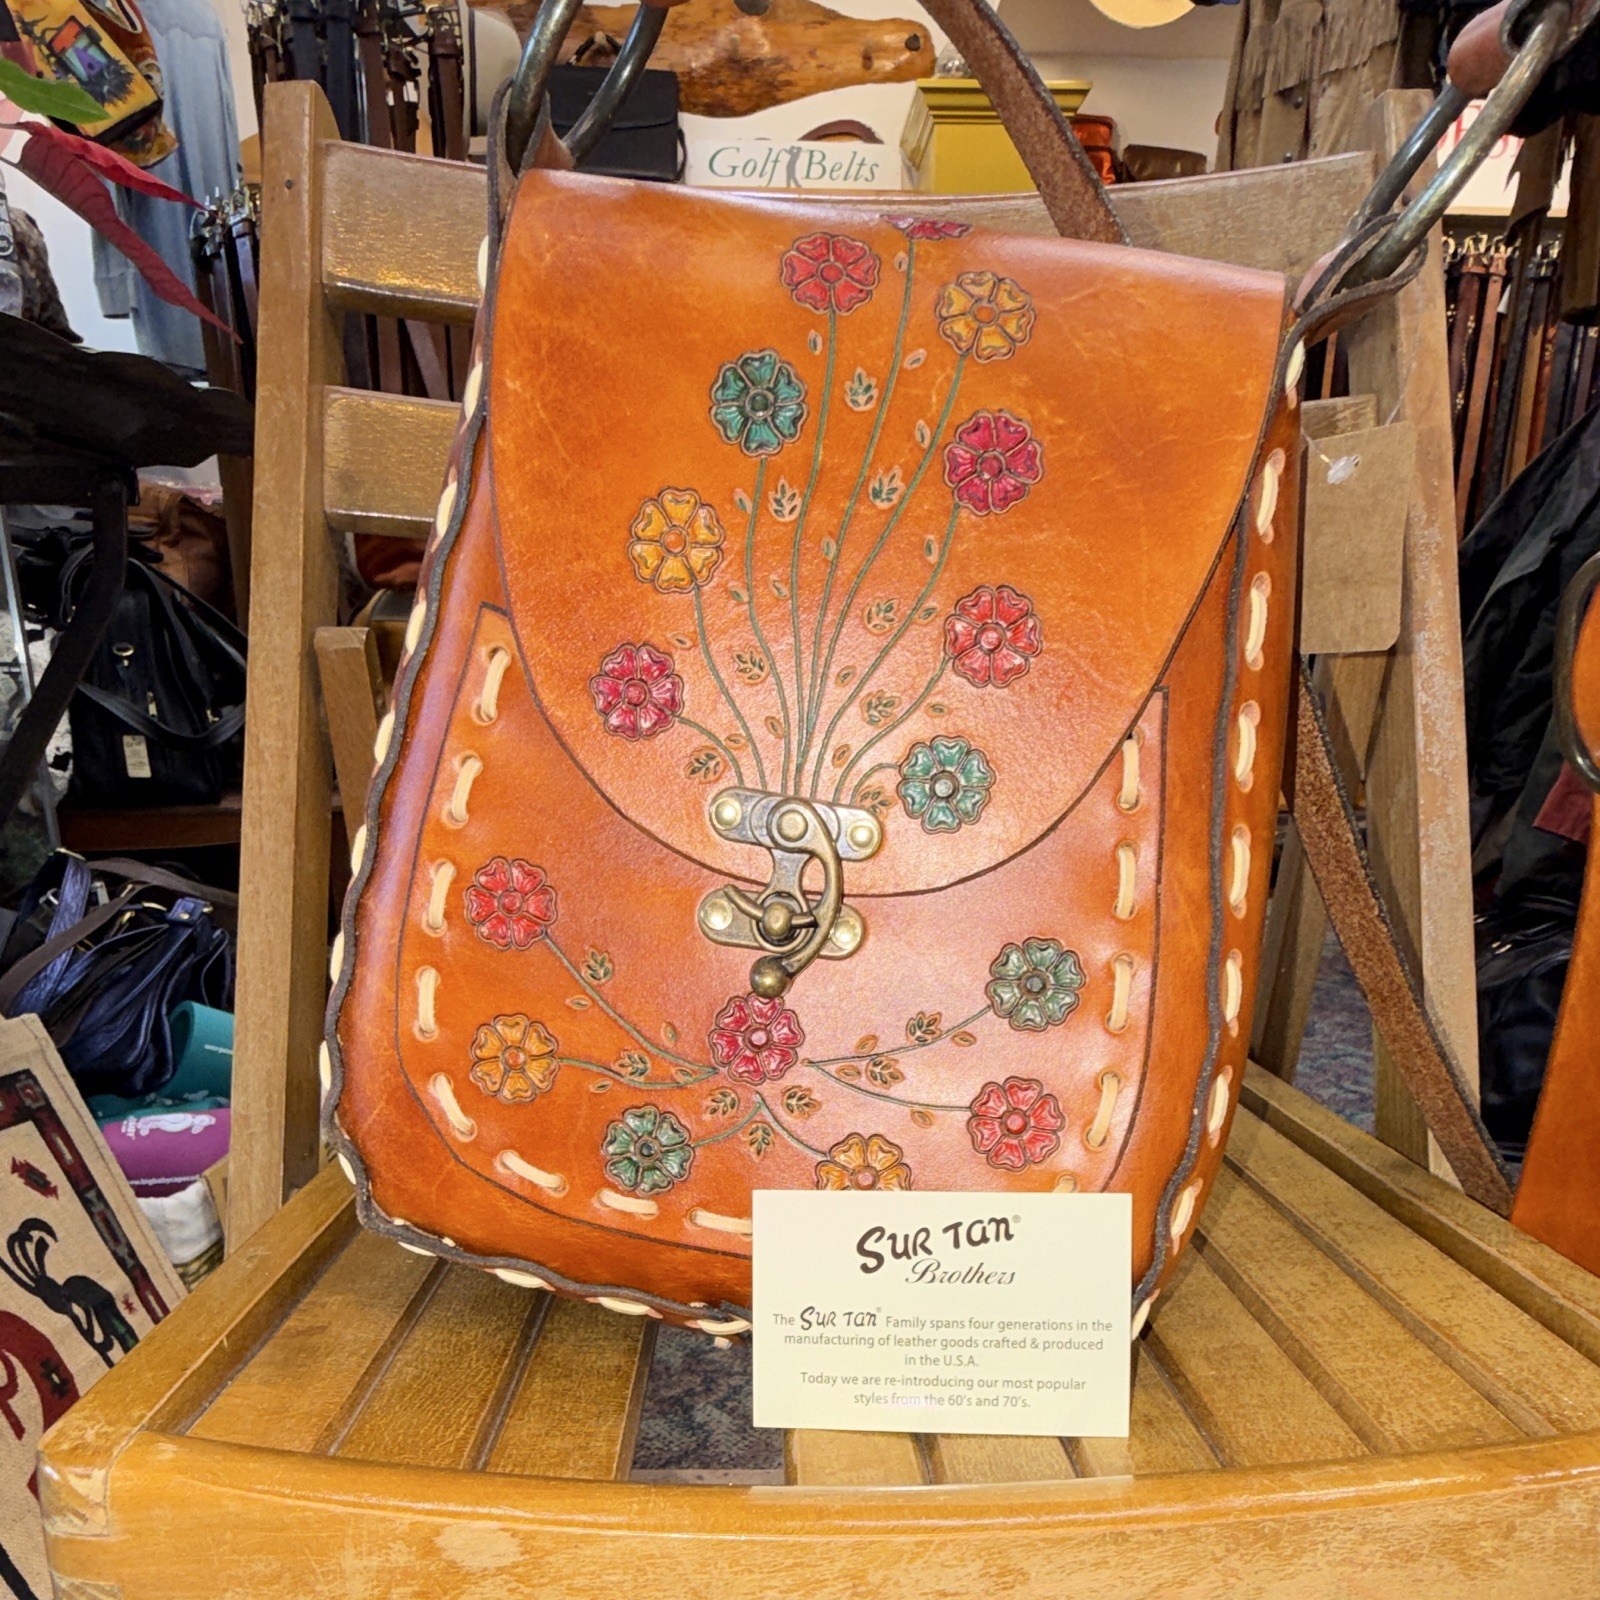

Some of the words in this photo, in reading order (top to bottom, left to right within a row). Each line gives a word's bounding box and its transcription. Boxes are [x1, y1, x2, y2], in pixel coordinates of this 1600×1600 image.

[708, 146, 787, 187] Golf
[801, 148, 879, 182] Belts
[905, 1258, 1016, 1285] Brothers
[773, 1313, 796, 1326] The
[886, 1316, 926, 1330] Family
[929, 1318, 966, 1331] spans
[968, 1317, 995, 1330] four
[997, 1319, 1073, 1333] generations
[1076, 1319, 1088, 1331] in
[1092, 1319, 1113, 1332] the
[784, 1333, 875, 1349] manufacturing
[877, 1334, 891, 1347] of
[893, 1335, 937, 1348] leather
[940, 1336, 979, 1351] goods
[982, 1336, 1027, 1350] crafted
[1030, 1337, 1039, 1350] &
[1042, 1338, 1104, 1353] produced
[904, 1354, 917, 1366] in
[919, 1355, 941, 1367] the
[943, 1354, 980, 1368] U.S.A.
[800, 1372, 838, 1388] Today
[841, 1375, 859, 1386] we
[861, 1376, 882, 1387] are
[884, 1374, 974, 1391] re-introducing
[977, 1378, 999, 1389] our
[1002, 1377, 1034, 1390] most
[1036, 1378, 1087, 1393] popular
[853, 1392, 889, 1407] styles
[891, 1392, 921, 1406] from
[924, 1393, 945, 1406] the
[975, 1395, 999, 1407] and
